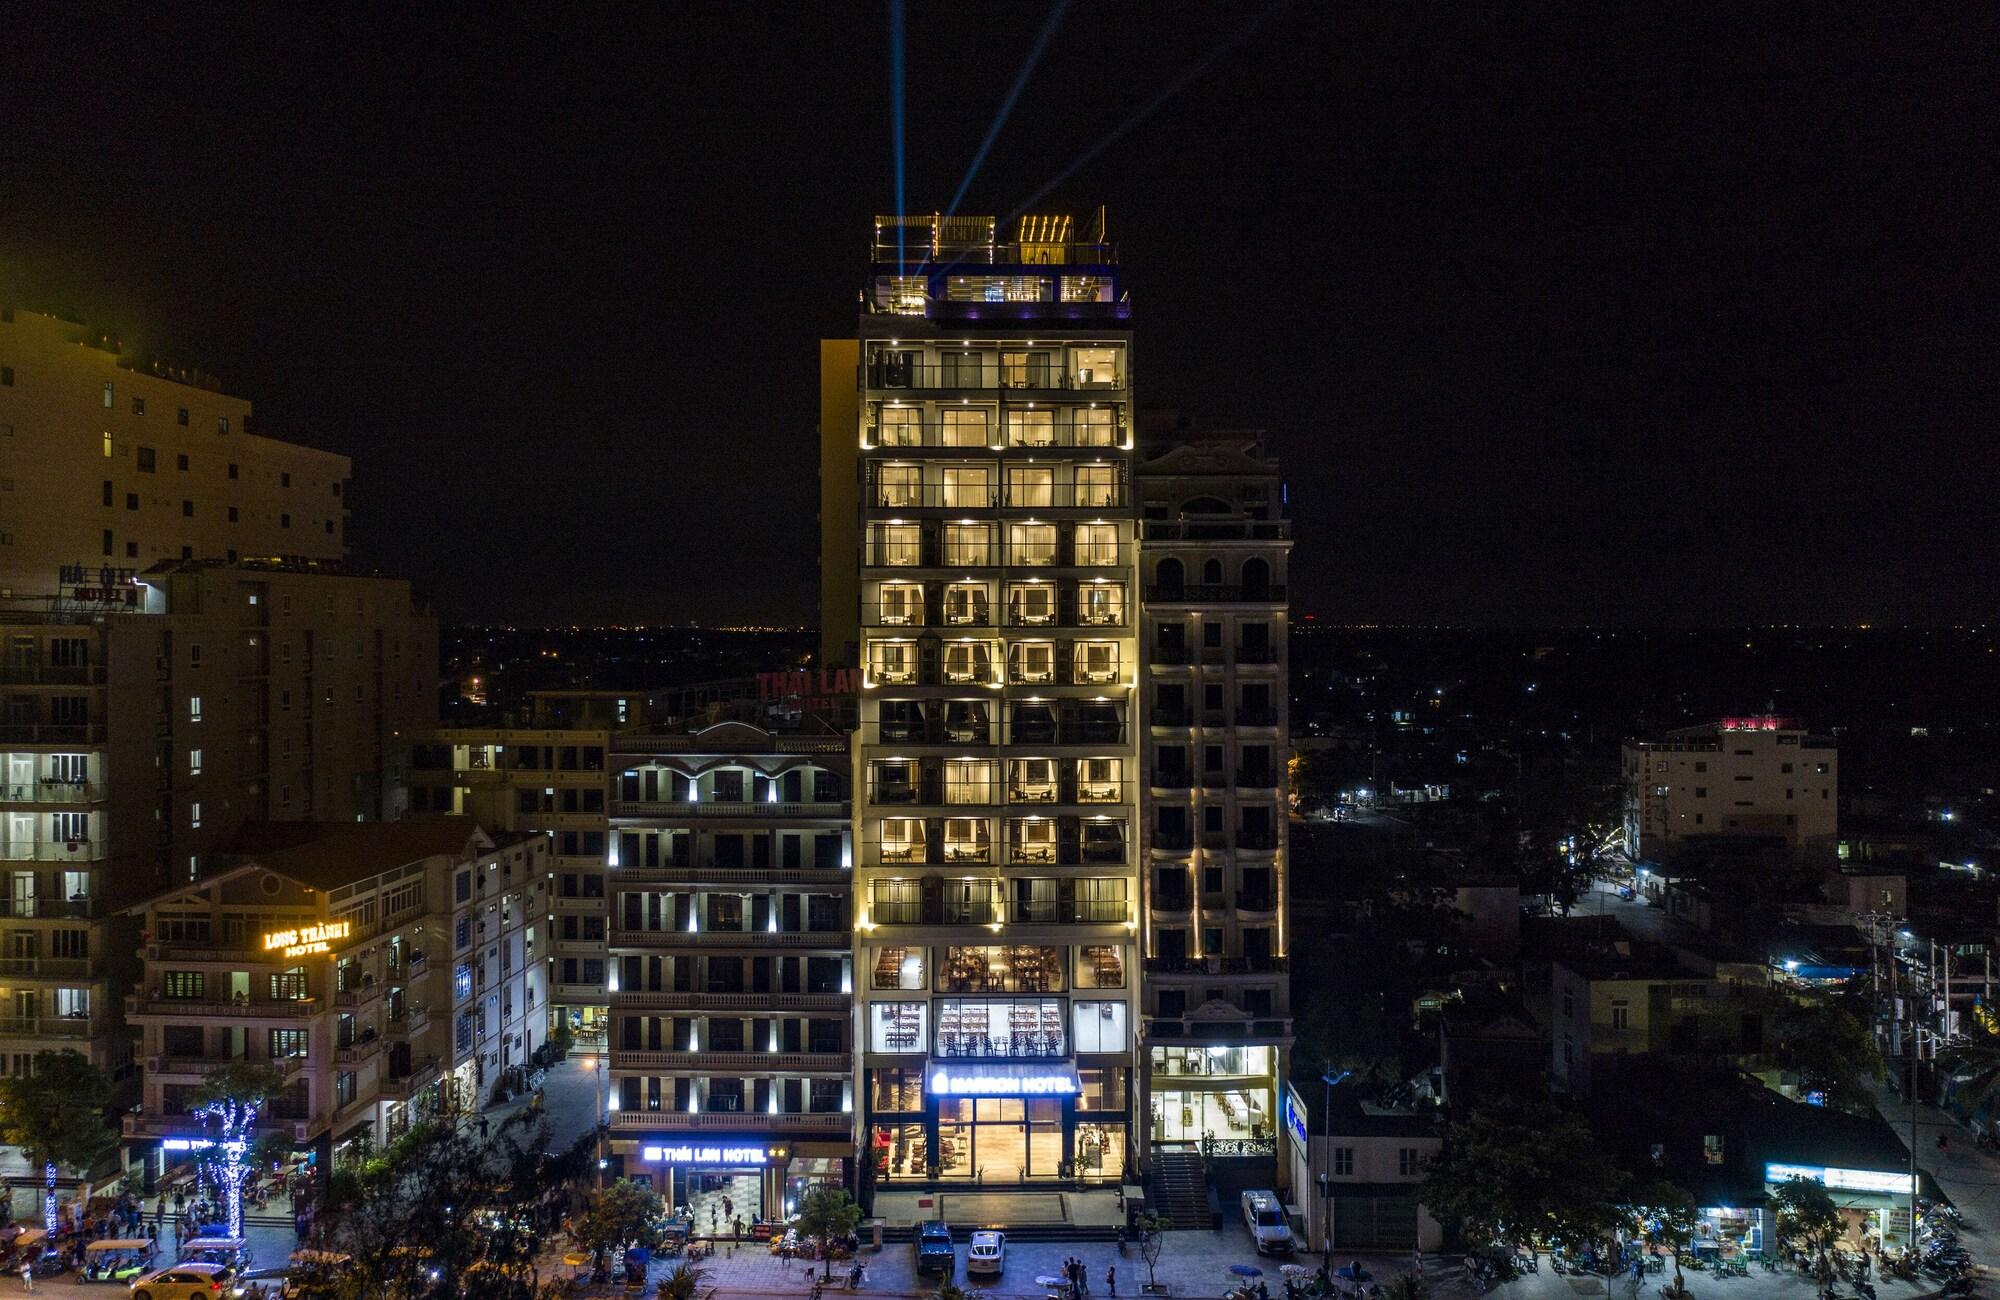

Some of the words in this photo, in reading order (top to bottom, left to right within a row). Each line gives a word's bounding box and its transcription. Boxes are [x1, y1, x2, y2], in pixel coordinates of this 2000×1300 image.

[264, 930, 298, 949] LONG
[285, 941, 331, 957] HOTEL
[1022, 1077, 1076, 1092] HOTEL
[695, 1148, 720, 1162] LAN
[723, 1148, 767, 1163] HOTEL
